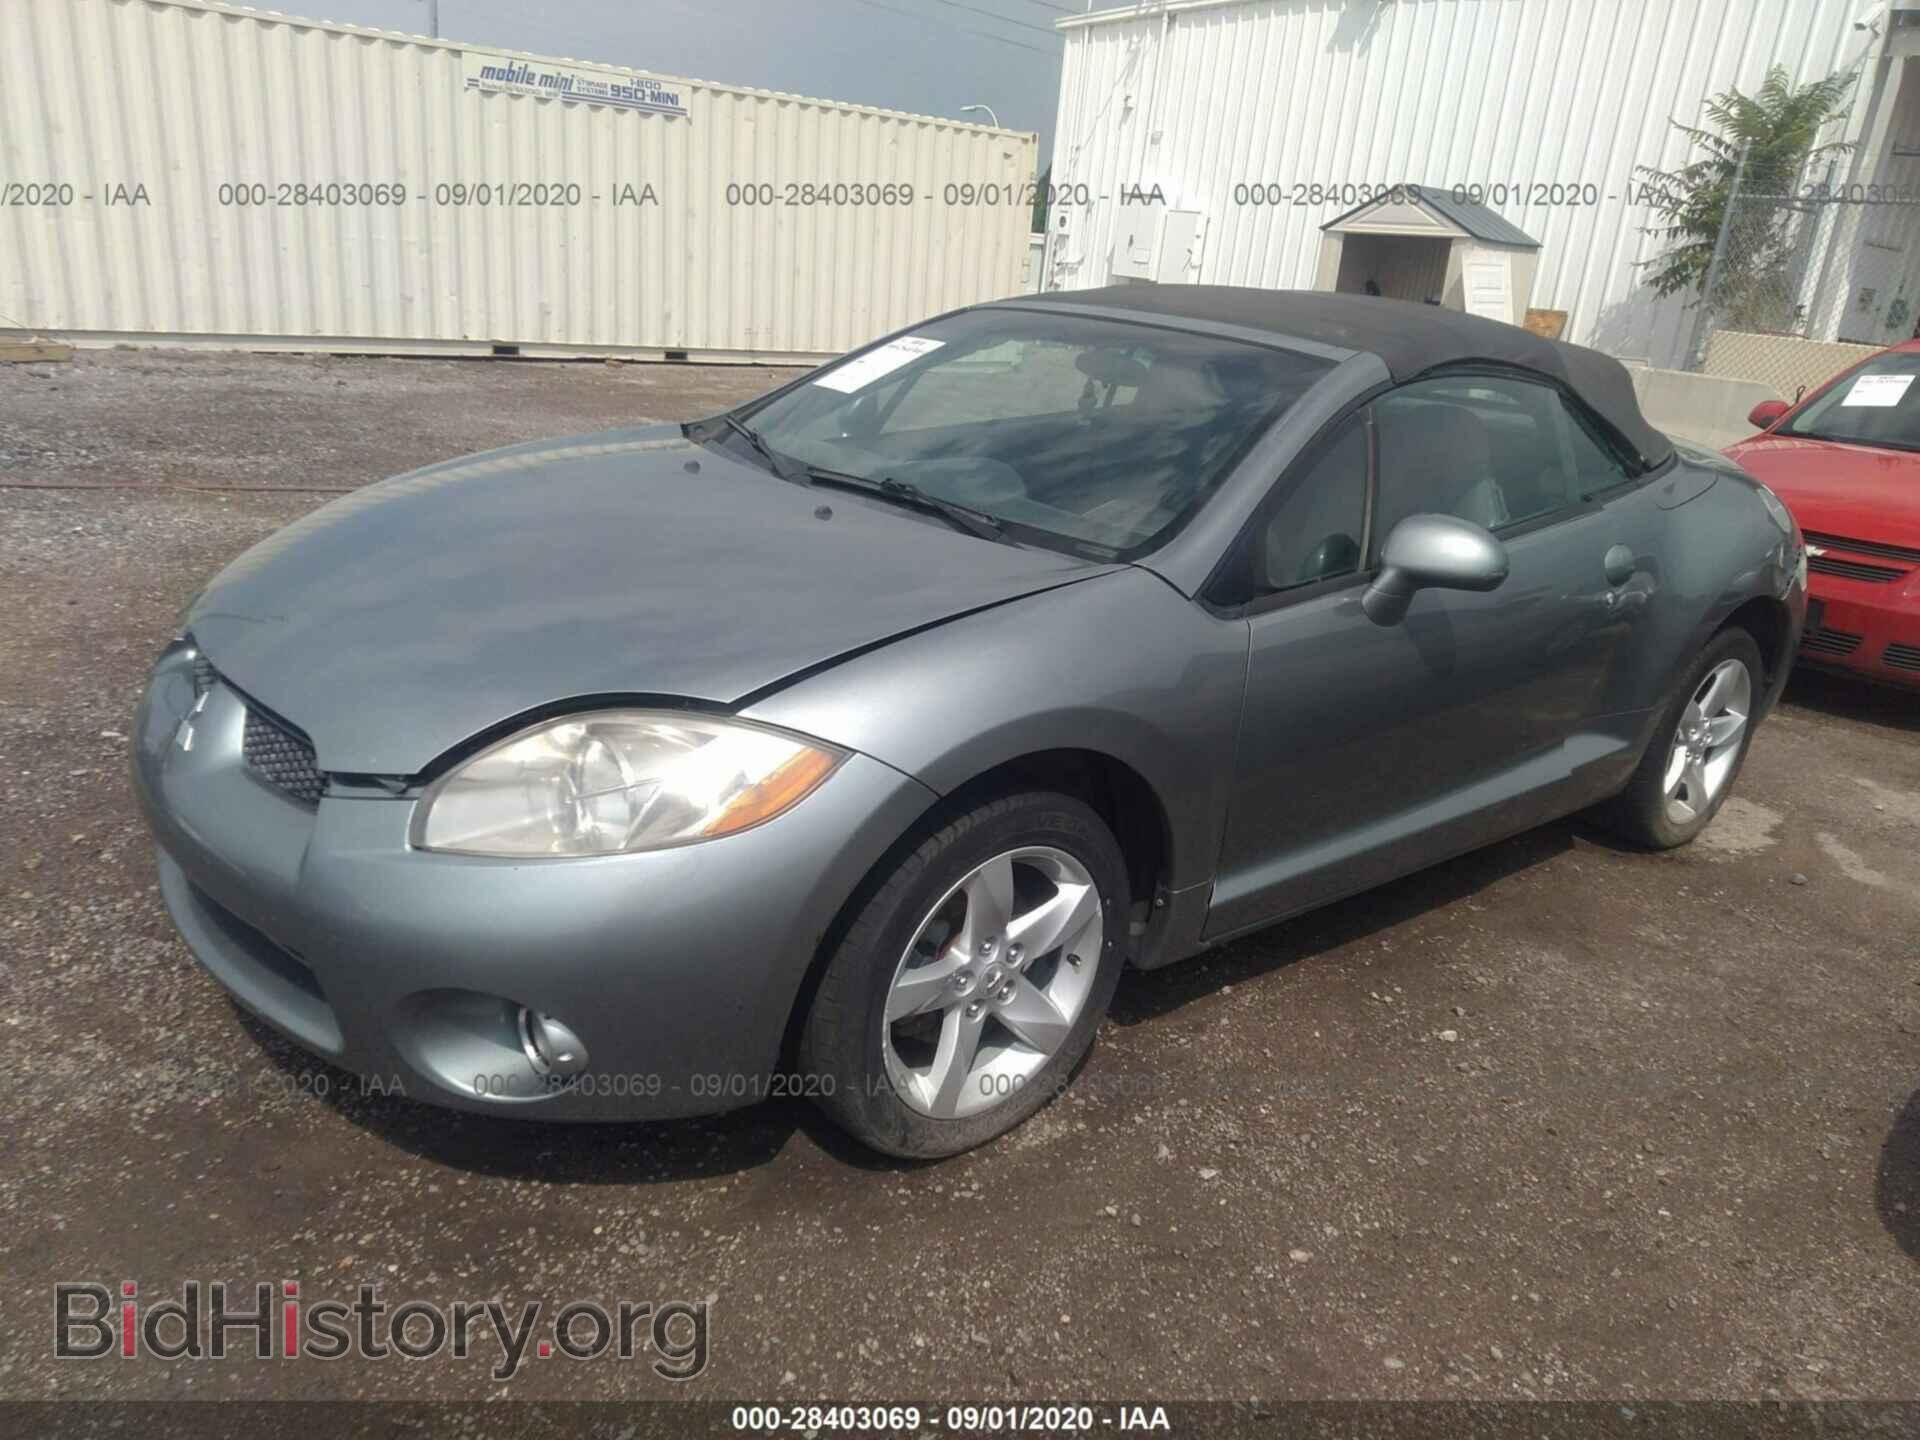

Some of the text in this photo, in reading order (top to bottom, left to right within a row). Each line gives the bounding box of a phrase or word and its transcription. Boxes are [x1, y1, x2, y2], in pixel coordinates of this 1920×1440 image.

[480, 60, 536, 85] mobile
[539, 71, 575, 91] mini
[610, 84, 679, 106] 950-MINI
